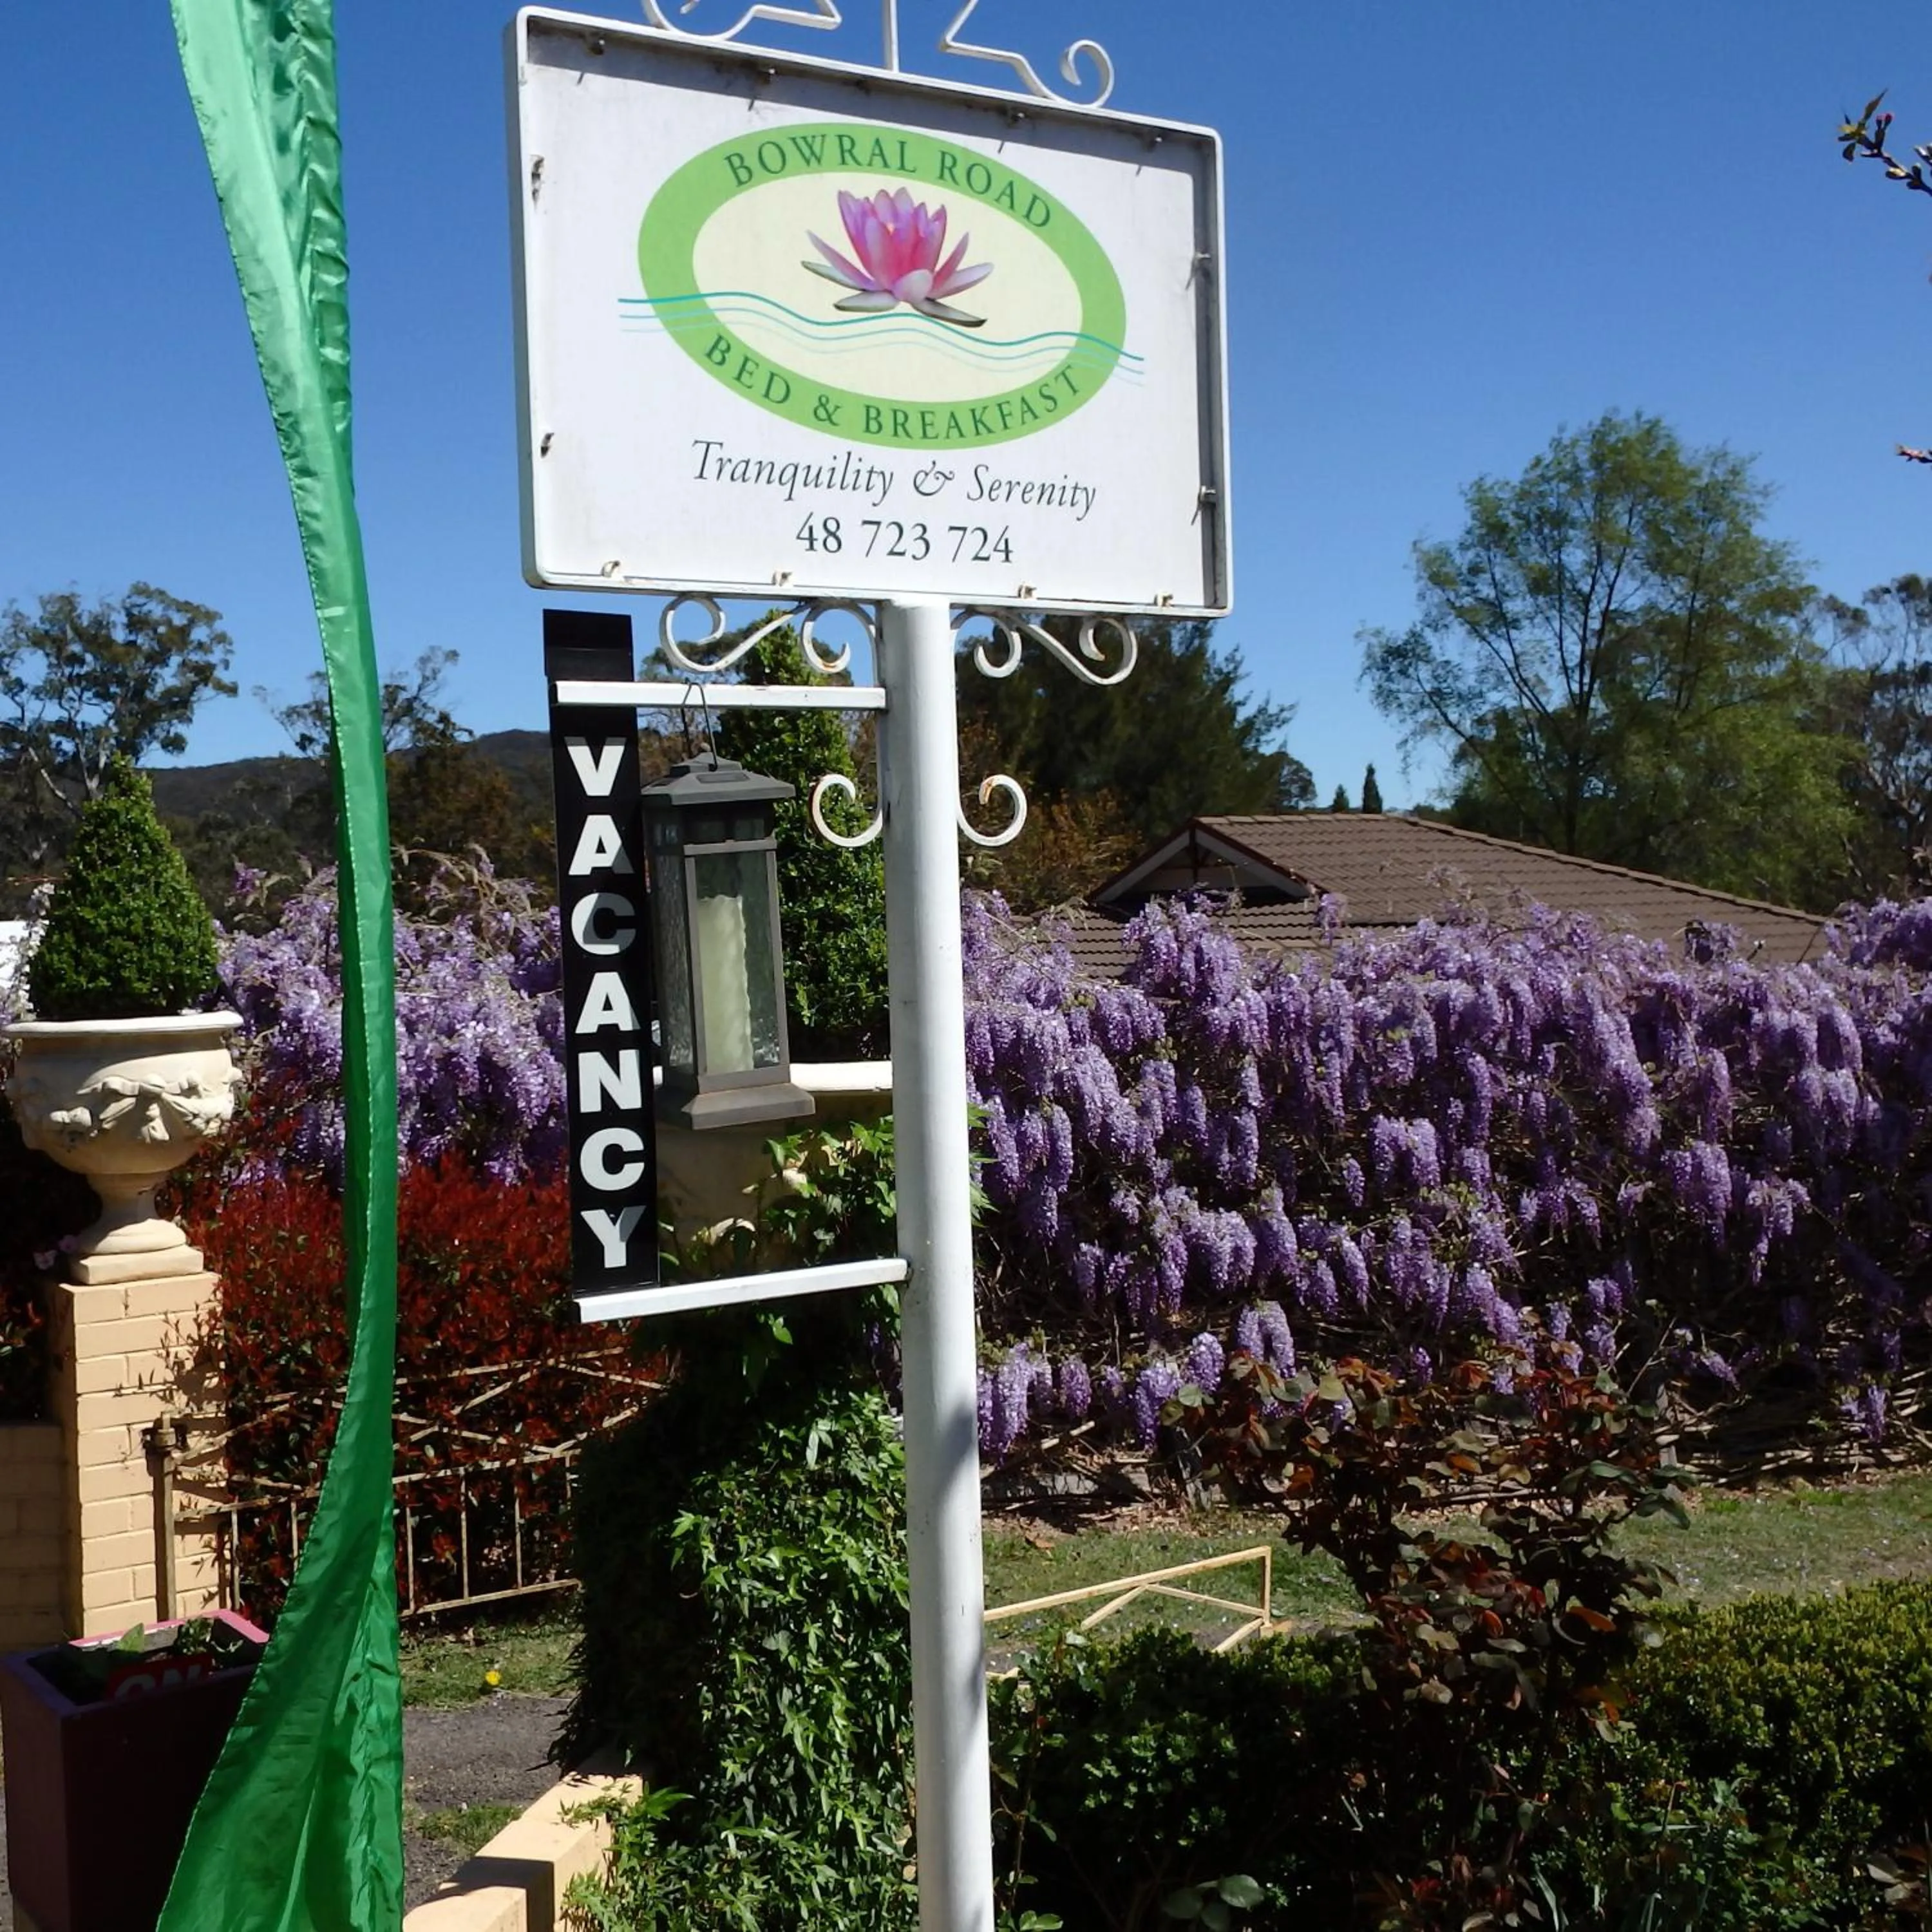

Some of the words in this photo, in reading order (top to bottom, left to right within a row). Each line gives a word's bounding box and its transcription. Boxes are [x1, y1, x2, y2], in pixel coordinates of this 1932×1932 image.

[724, 133, 917, 187] BOWRAL
[938, 150, 1052, 229] ROAD
[705, 334, 791, 405] BED
[813, 394, 842, 426] &
[863, 365, 1082, 440] BREAKFAST
[692, 440, 895, 507] Tranquility
[913, 460, 955, 497] &
[967, 464, 1097, 521] Serenity
[796, 512, 843, 553] 48
[861, 520, 931, 560] 723
[947, 525, 1014, 564] 724
[565, 736, 645, 1269] VACANCY
